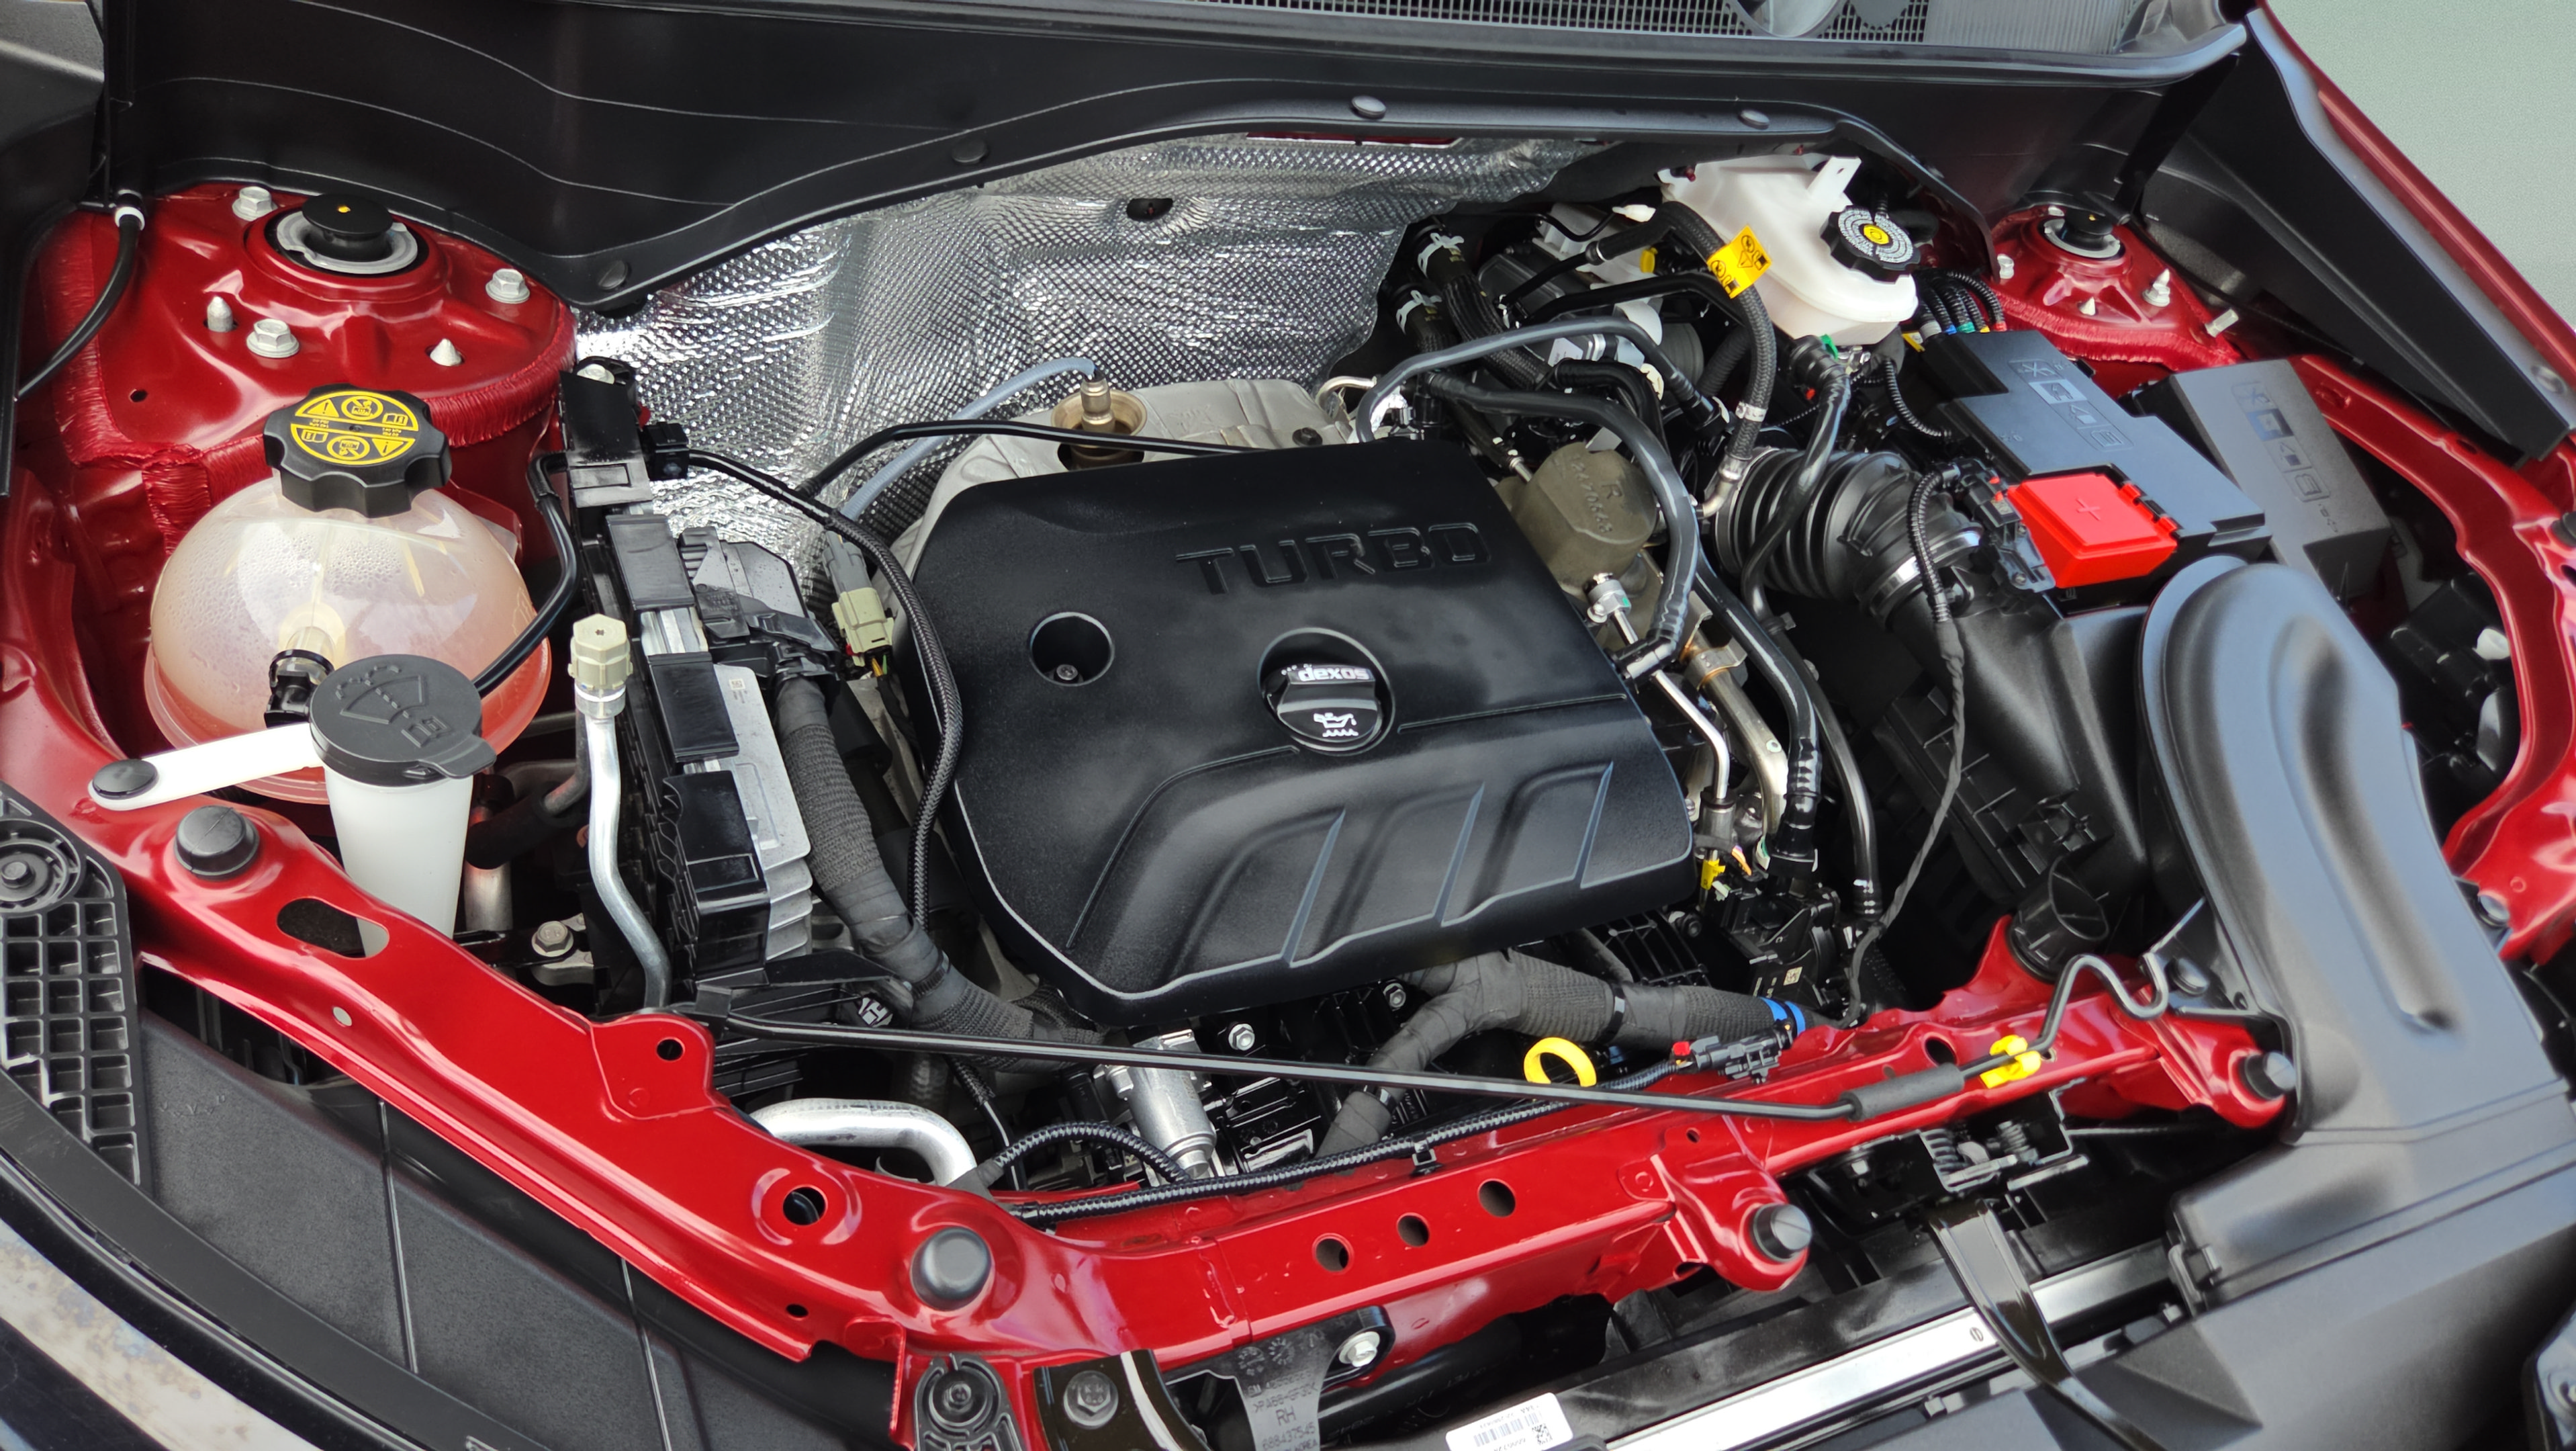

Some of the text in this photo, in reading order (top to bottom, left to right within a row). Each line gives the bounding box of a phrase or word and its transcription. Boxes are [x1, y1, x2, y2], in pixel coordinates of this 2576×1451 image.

[1175, 523, 1491, 595] TURBO
[1298, 667, 1370, 682] dexos
[1276, 1405, 1296, 1425] RH
